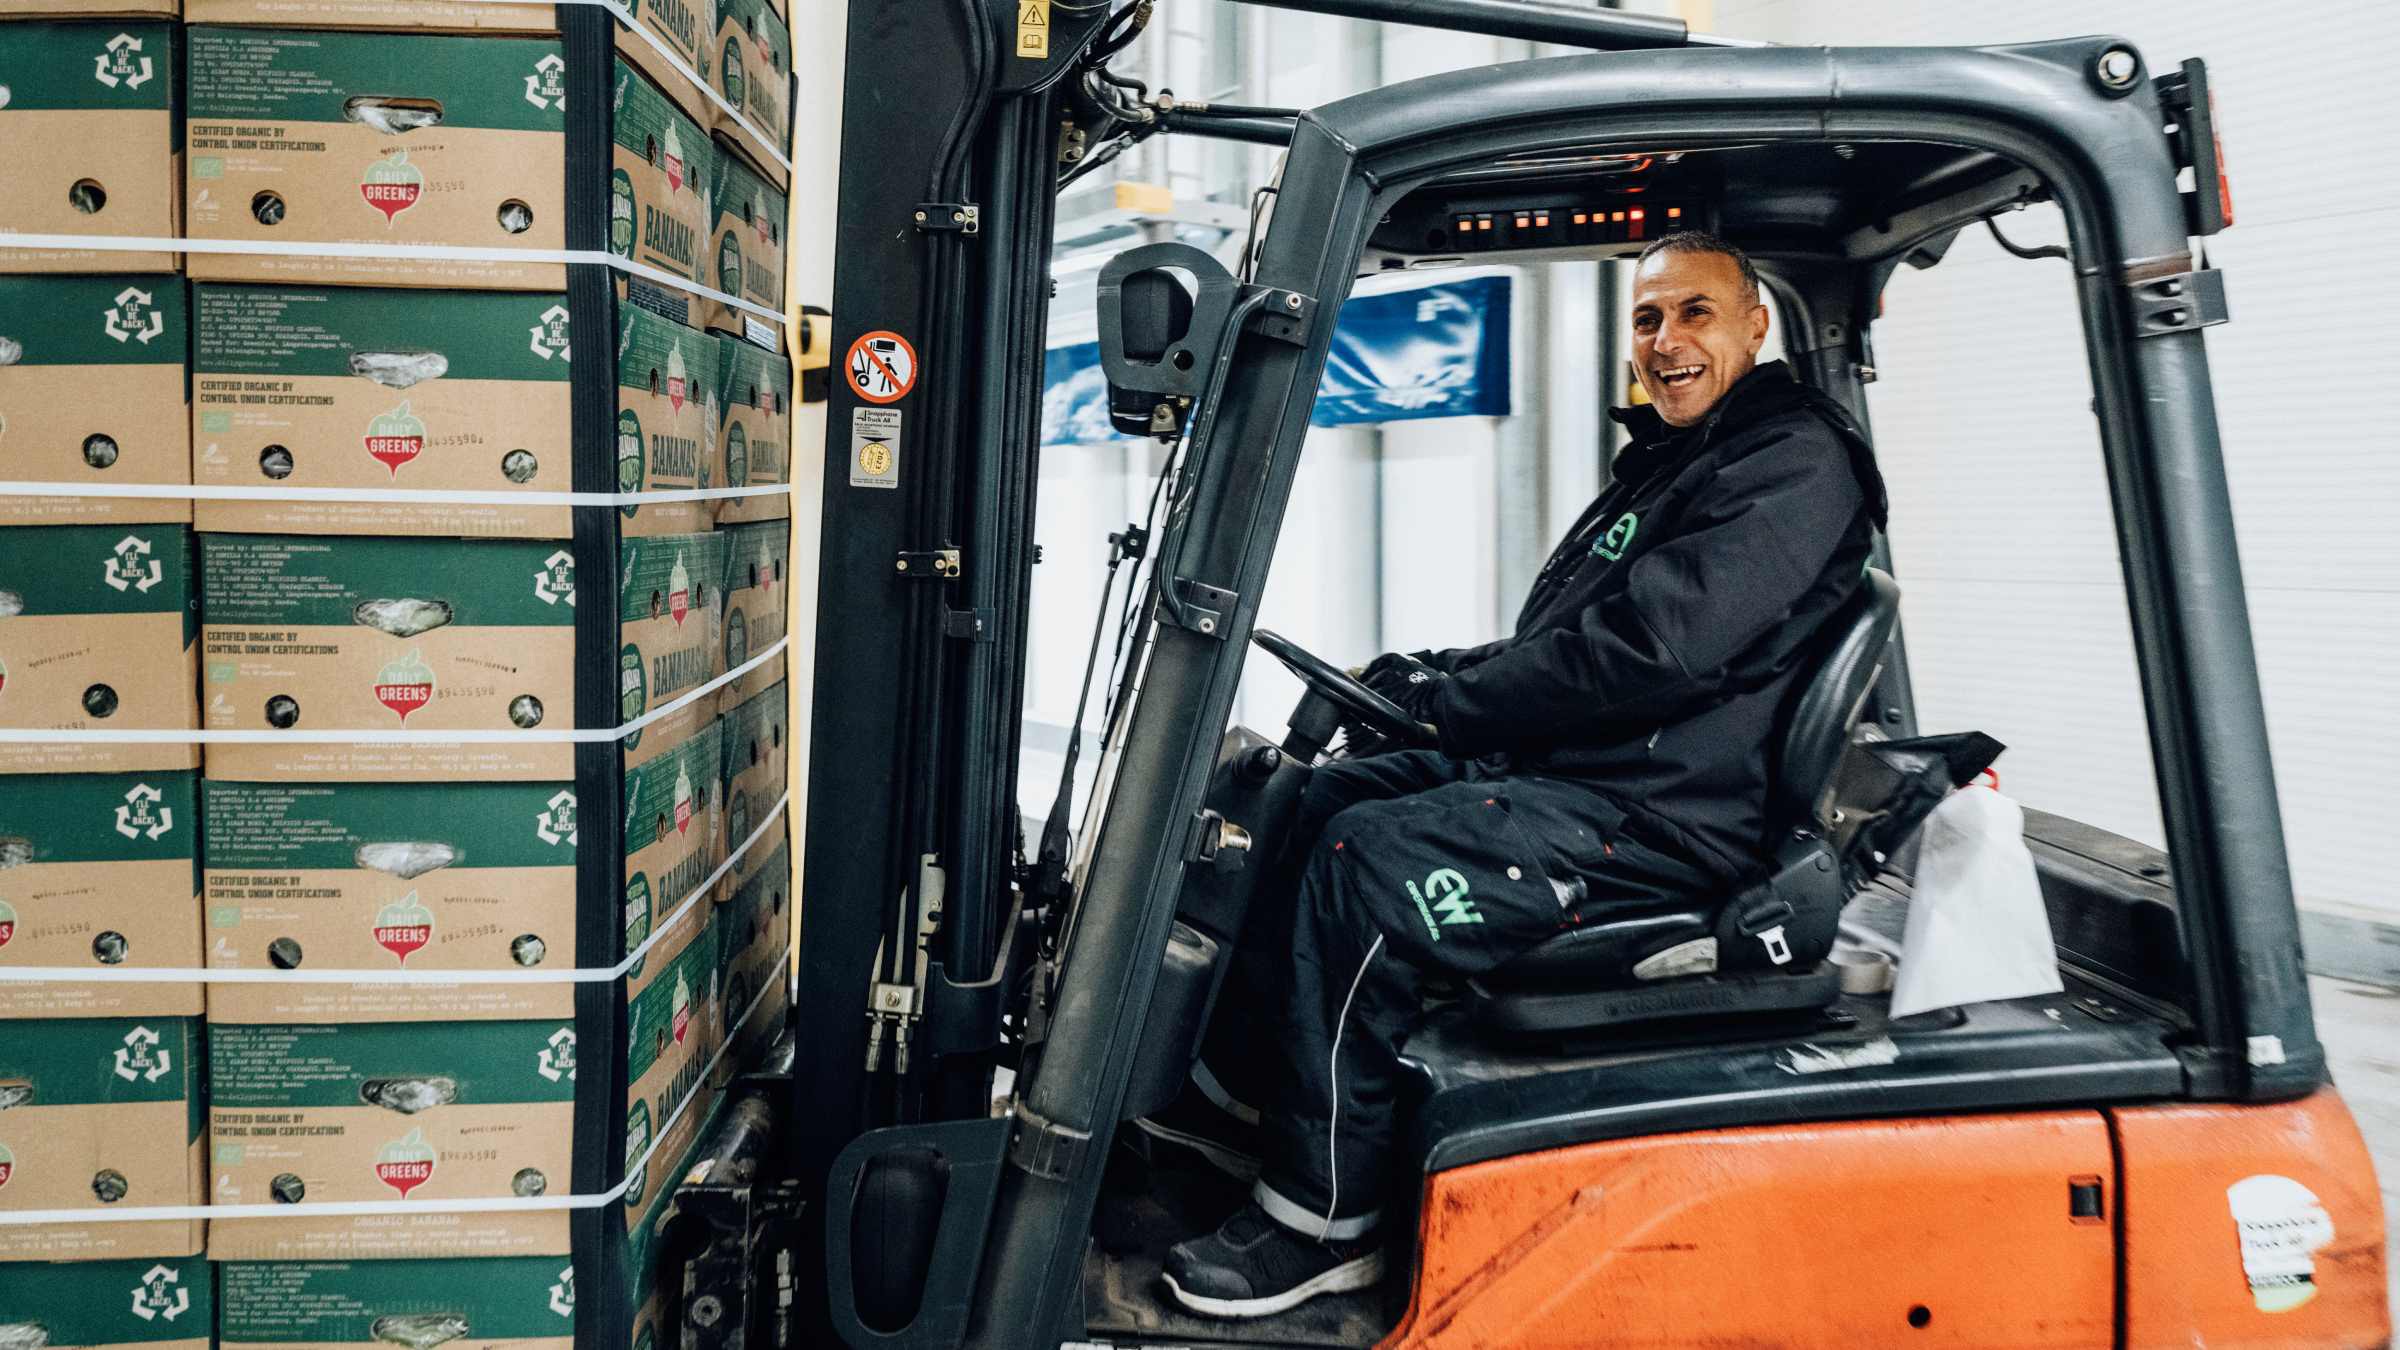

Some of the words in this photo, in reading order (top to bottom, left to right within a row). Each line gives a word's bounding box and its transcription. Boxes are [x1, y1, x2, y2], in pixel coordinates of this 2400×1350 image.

[193, 126, 234, 137] CERTIFIED
[236, 126, 272, 137] ORGANIC
[274, 126, 285, 137] BY
[192, 139, 229, 150] CONTROL
[231, 139, 257, 150] UNION
[259, 140, 327, 152] CERTIFICATIONS
[367, 185, 415, 201] GREENS
[645, 204, 695, 267] BANANAS
[126, 303, 139, 313] I'LL
[122, 320, 145, 329] BACK!
[200, 381, 242, 391] CERTIFIED
[244, 382, 279, 392] ORGANIC
[282, 382, 293, 392] BY
[200, 394, 237, 404] CONTROL
[240, 394, 265, 404] UNION
[268, 395, 334, 406] CERTIFICATIONS
[379, 424, 413, 435] DAILY
[370, 438, 418, 453] GREENS
[652, 434, 697, 478] BANANAS
[207, 632, 246, 642] CERTIFIED
[248, 632, 284, 642] ORGANIC
[287, 632, 297, 642] BY
[207, 644, 243, 655] CONTROL
[245, 645, 270, 655] UNION
[273, 645, 339, 655] CERTIFICATIONS
[379, 687, 428, 701] GREENS
[210, 876, 249, 886] CERTIFIED
[251, 876, 288, 886] ORGANIC
[290, 877, 300, 886] BY
[210, 889, 245, 898] CONTROL
[248, 889, 274, 898] UNION
[276, 889, 341, 899] CERTIFICATIONS
[379, 928, 427, 943] GREENS
[213, 1114, 252, 1124] CERTIFIED
[255, 1114, 290, 1124] ORGANIC
[293, 1114, 304, 1124] BY
[213, 1127, 249, 1137] CONTROL
[252, 1126, 277, 1136] UNION
[279, 1126, 345, 1136] CERTIFICATIONS
[381, 1164, 429, 1179] GREENS
